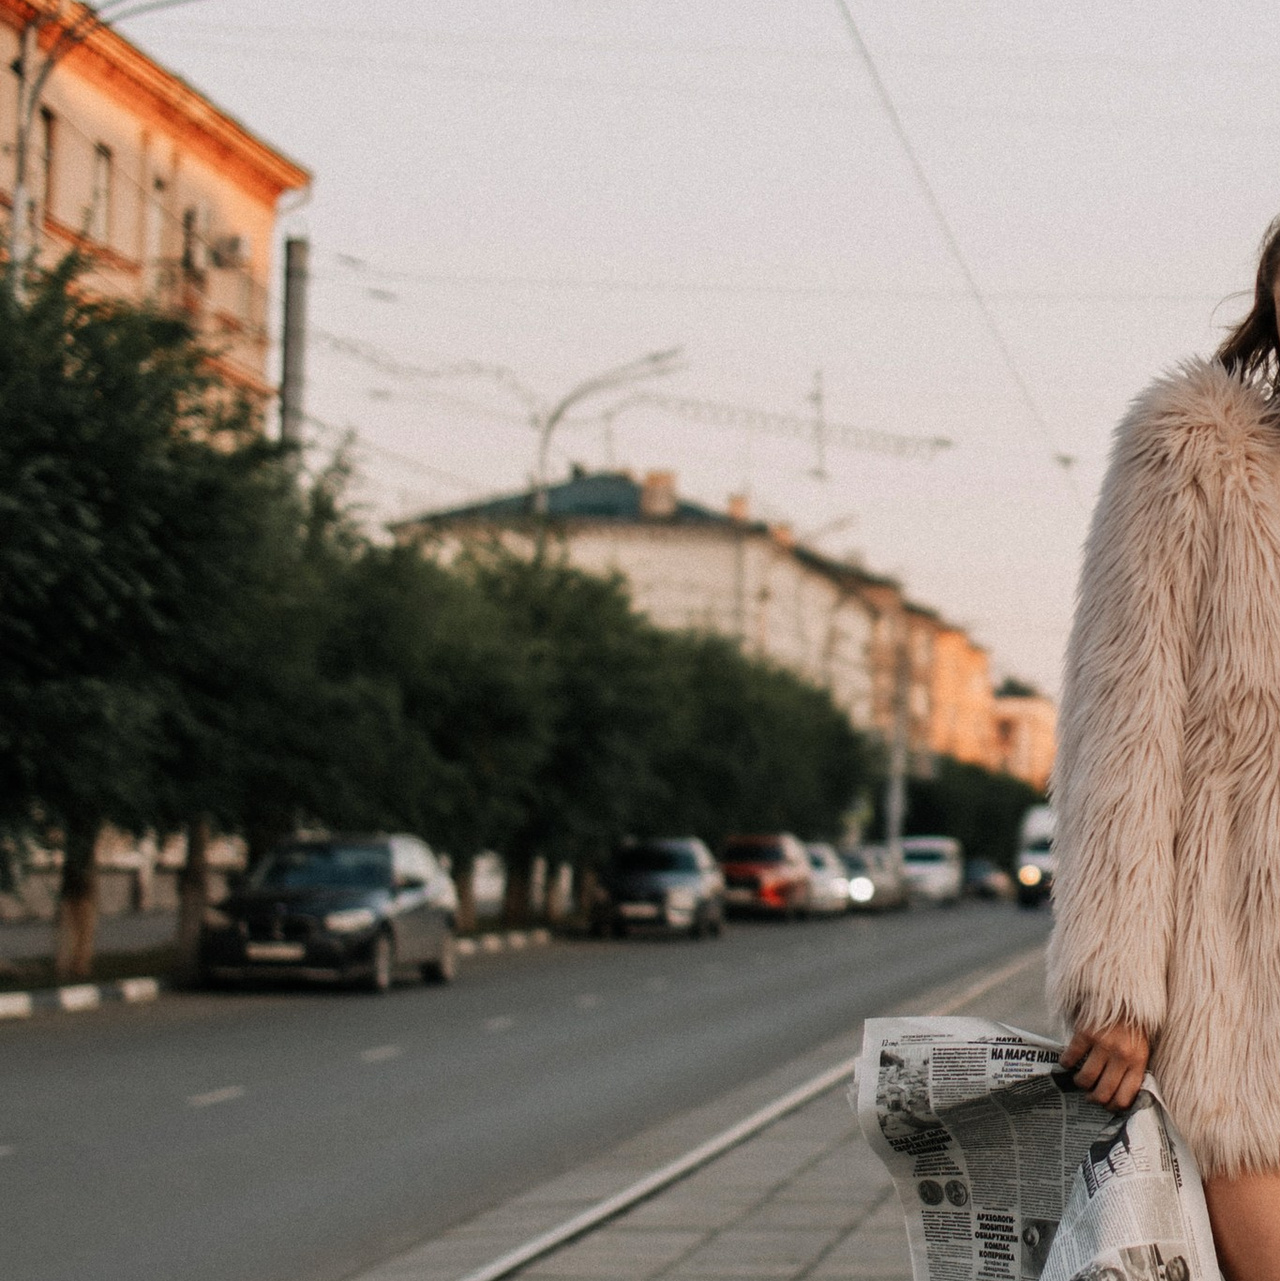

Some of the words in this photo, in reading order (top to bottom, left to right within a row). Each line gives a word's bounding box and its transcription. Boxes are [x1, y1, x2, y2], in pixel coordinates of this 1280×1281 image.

[991, 1048, 1003, 1060] НА
[1004, 1048, 1036, 1061] МАРСЕ
[1173, 1158, 1183, 1188] УТРАТА
[977, 1213, 1015, 1224] АРХЕОЛОГИ-
[980, 1223, 1013, 1233] ЛЮБИТЕЛИ
[975, 1231, 1018, 1242] ОБНАРУЖИЛИ
[984, 1242, 1009, 1251] КОМПАС
[979, 1250, 1014, 1261] КОПЕРНИКА
